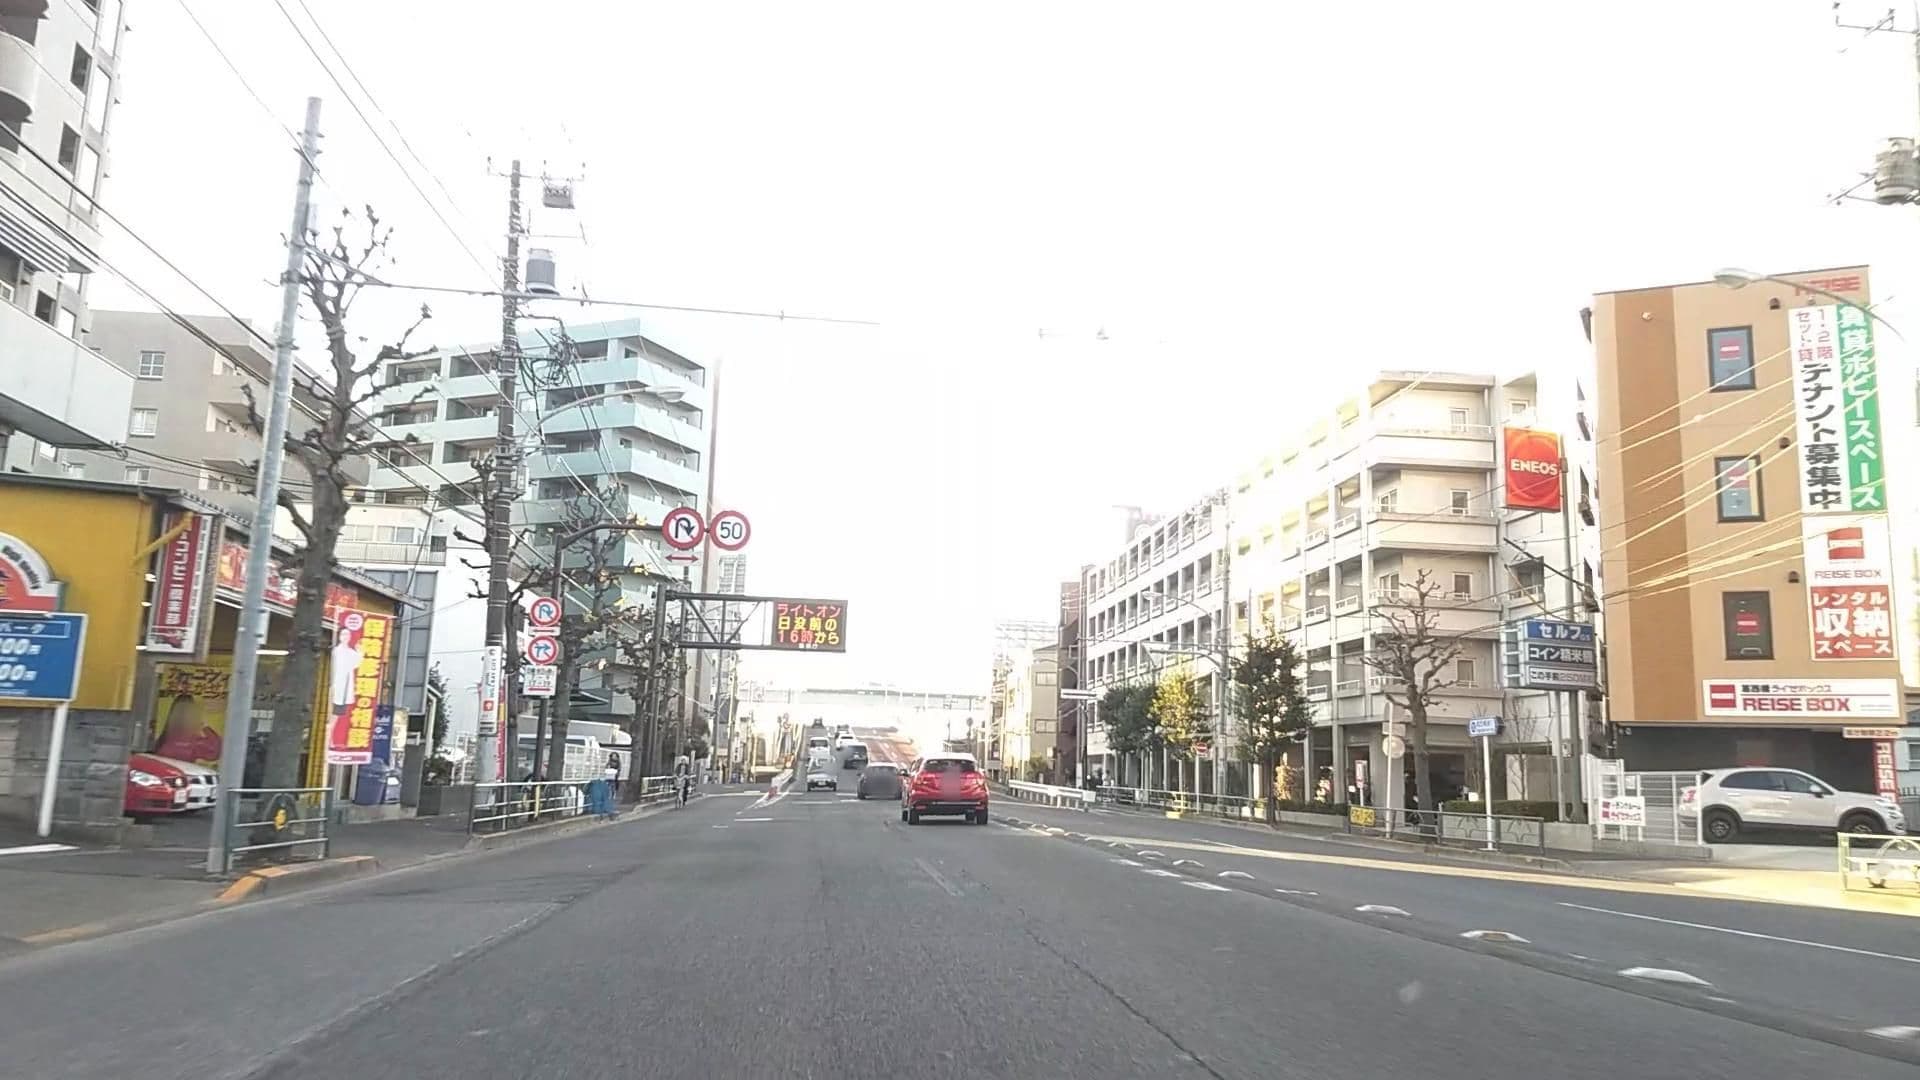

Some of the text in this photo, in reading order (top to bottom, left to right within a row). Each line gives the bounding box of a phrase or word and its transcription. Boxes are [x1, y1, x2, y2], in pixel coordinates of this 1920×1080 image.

[1800, 362, 1842, 509] テナント募集中
[1510, 458, 1558, 476] ENEOS
[720, 521, 743, 539] 50
[1814, 570, 1881, 579] REISE BOX
[1812, 590, 1888, 607] レンタル
[777, 603, 841, 618] ライトオン
[778, 615, 838, 632] 日没前の
[1815, 606, 1891, 639] 収納
[778, 630, 840, 645] 16時から
[1539, 623, 1581, 640] セルフ
[1815, 640, 1890, 655] スペース
[1742, 698, 1803, 711] REISE
[1806, 698, 1851, 711] BOX
[1876, 741, 1894, 790] REISE
